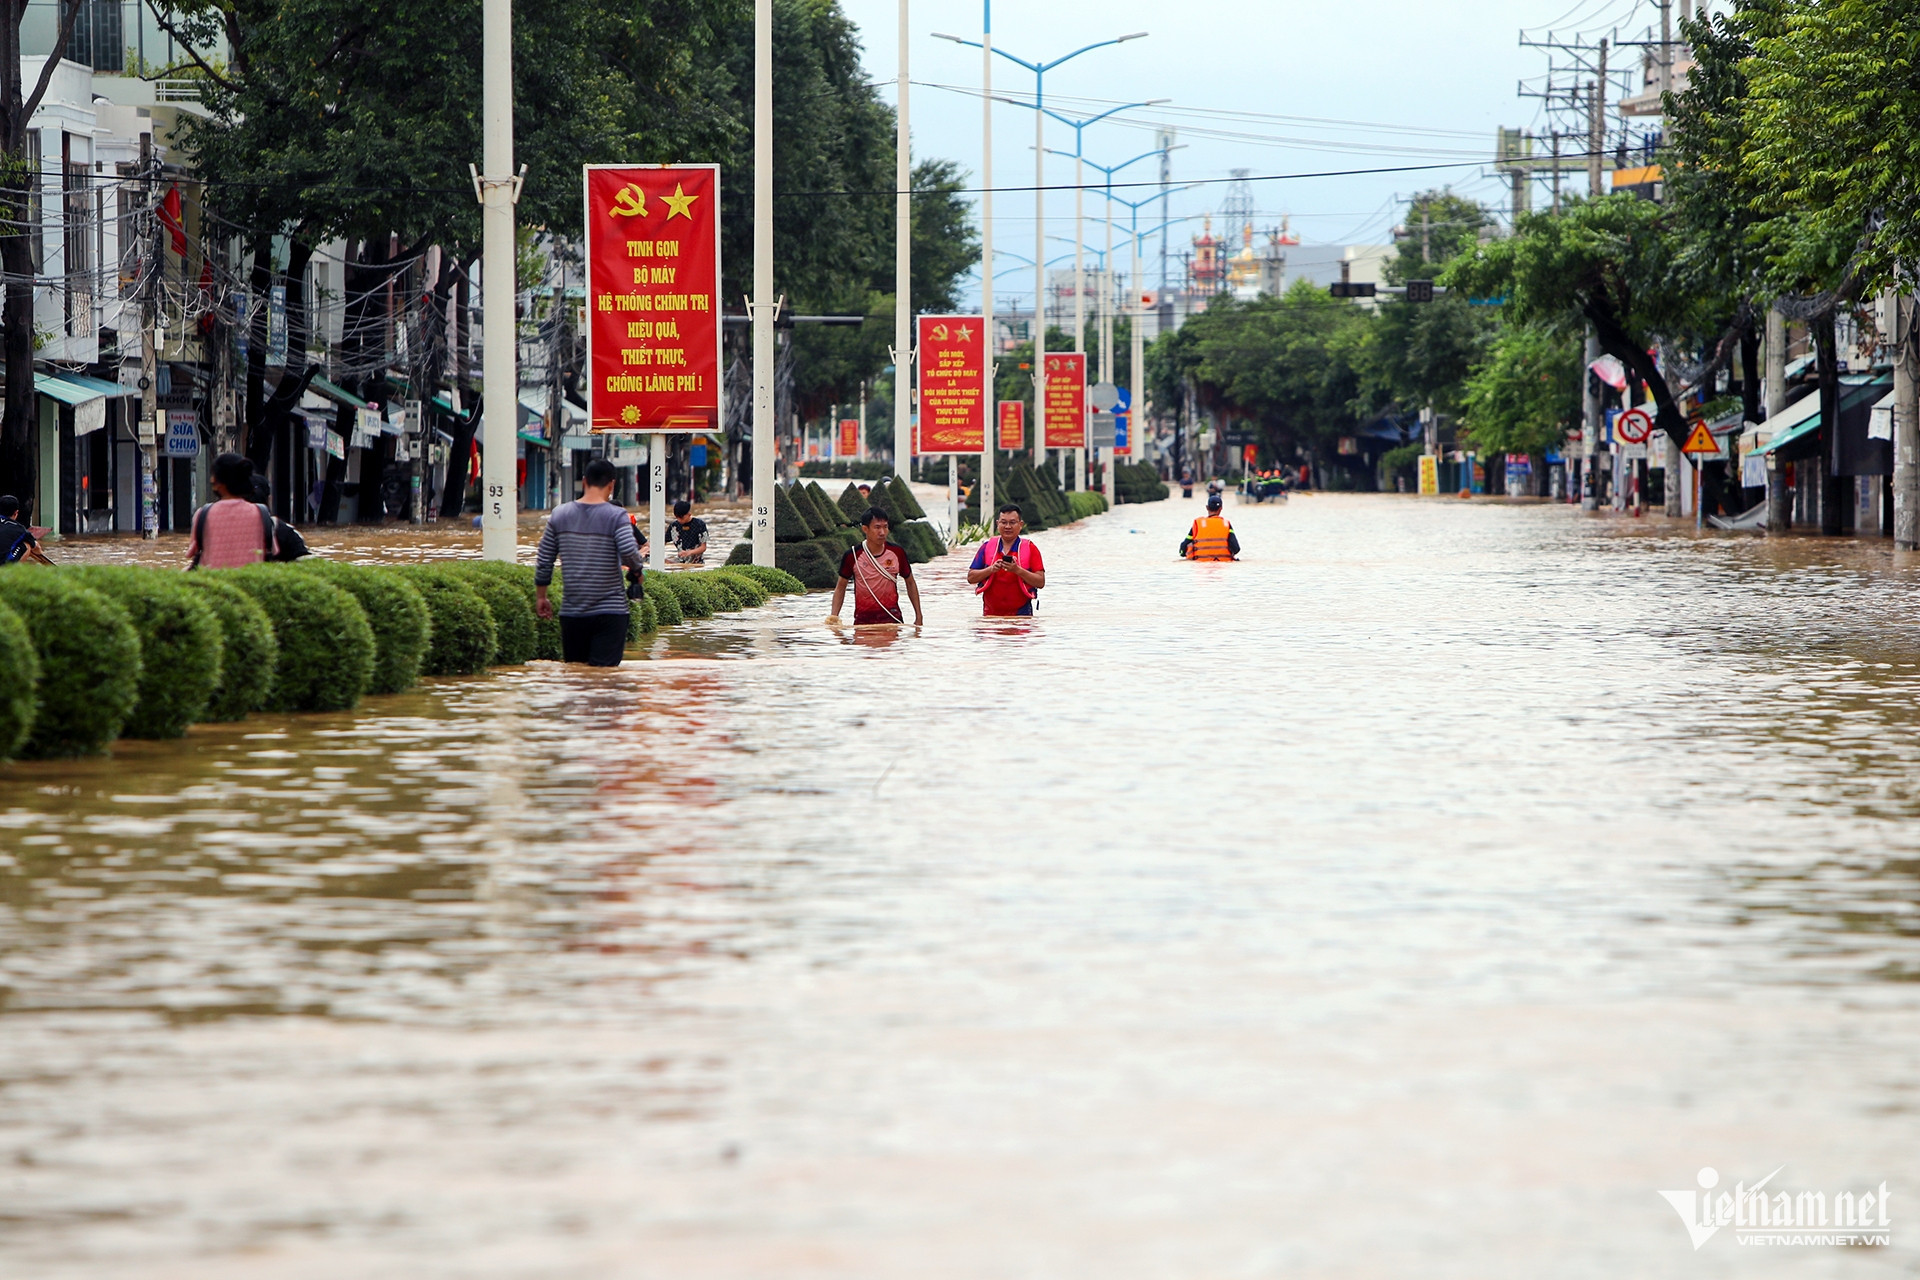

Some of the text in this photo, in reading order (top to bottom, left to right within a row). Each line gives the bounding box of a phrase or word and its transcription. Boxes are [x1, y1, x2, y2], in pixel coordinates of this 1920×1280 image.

[627, 241, 678, 260] TINH GỌN
[634, 264, 676, 287] BỘ MÁY
[598, 289, 708, 314] HỆ THỐNG CHÍNH TRỊ
[628, 318, 680, 341] HIỆU QUẢ,
[621, 343, 687, 368] THIẾT THỰC,
[607, 370, 642, 392] CHỐNG
[677, 372, 696, 391] PHÍ
[699, 376, 702, 391] !
[173, 422, 193, 435] SỮA
[169, 439, 196, 449] CHUA
[655, 465, 661, 476] 2
[489, 485, 503, 497] 93
[494, 503, 501, 514] 5
[758, 507, 767, 515] 93
